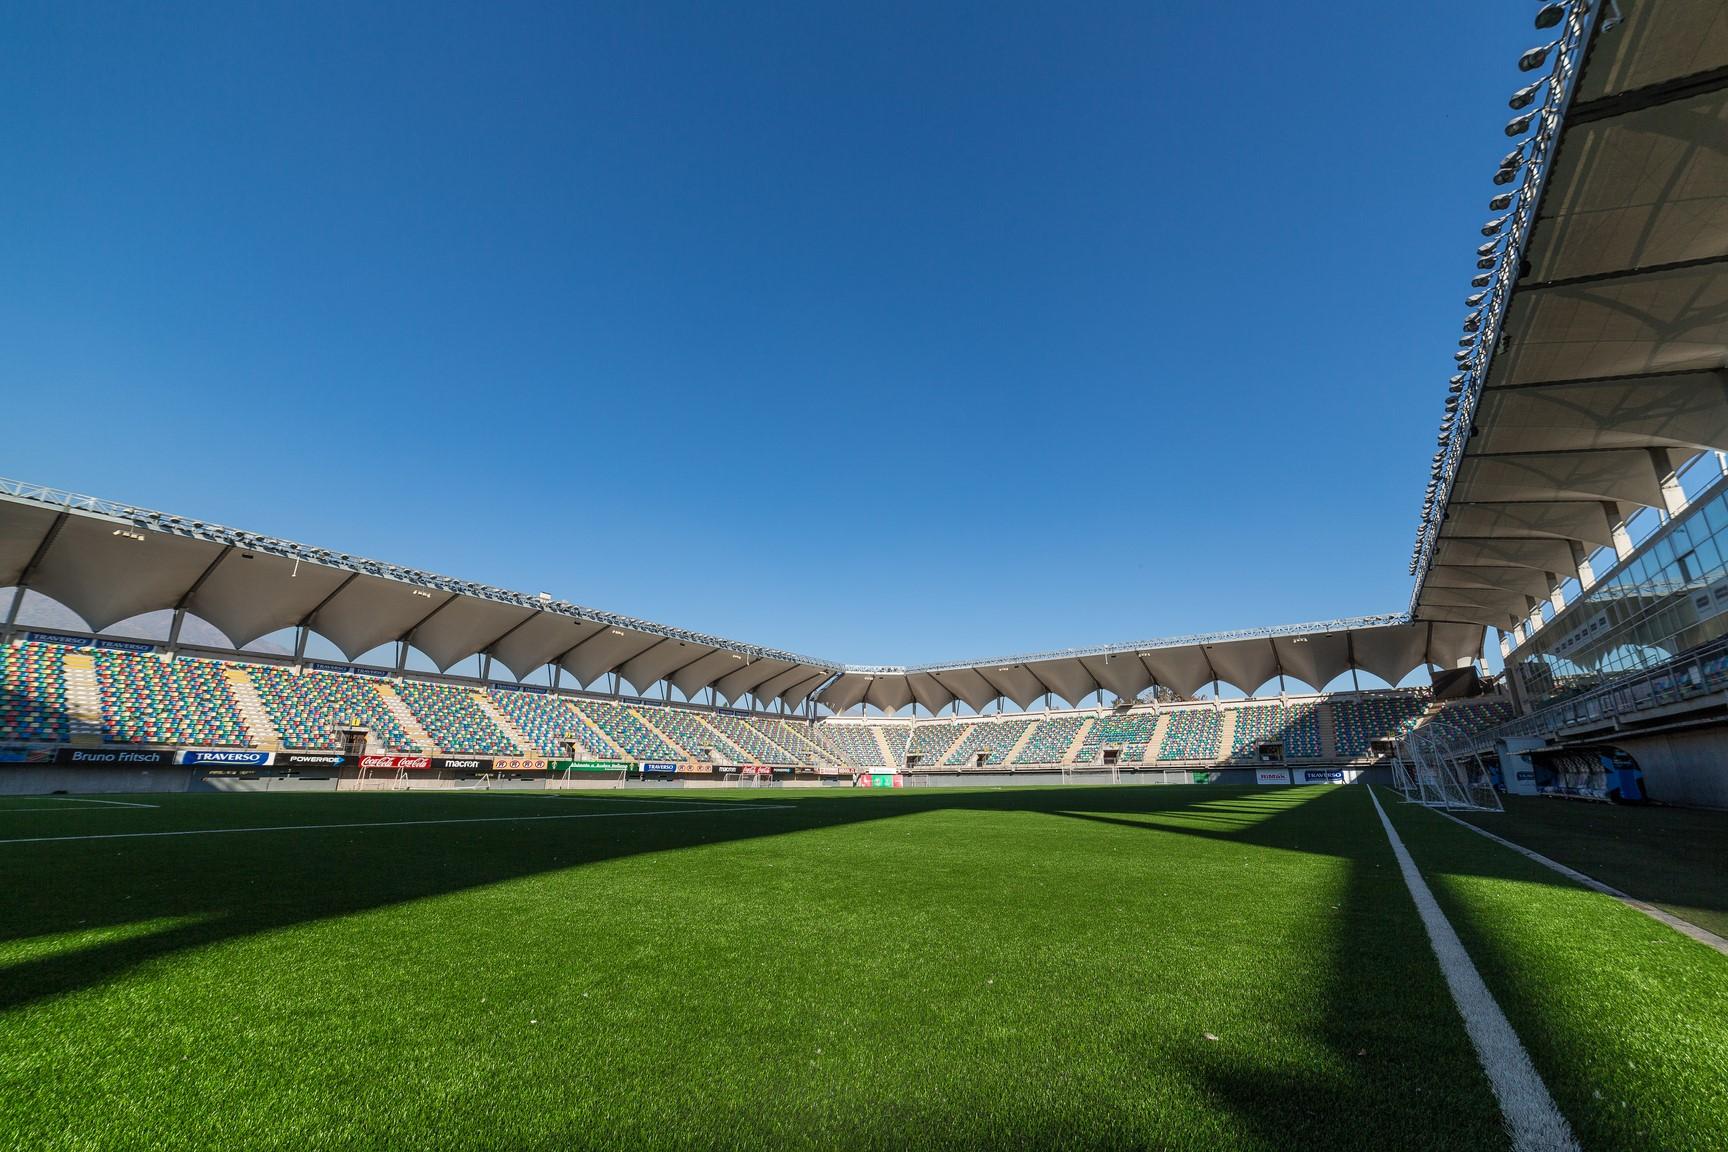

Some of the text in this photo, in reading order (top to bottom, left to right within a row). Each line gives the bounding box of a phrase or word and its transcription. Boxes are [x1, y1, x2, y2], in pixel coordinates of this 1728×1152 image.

[72, 751, 160, 762] Bruno Fritsch
[195, 752, 260, 761] TRAVERSO
[445, 760, 479, 768] macron
